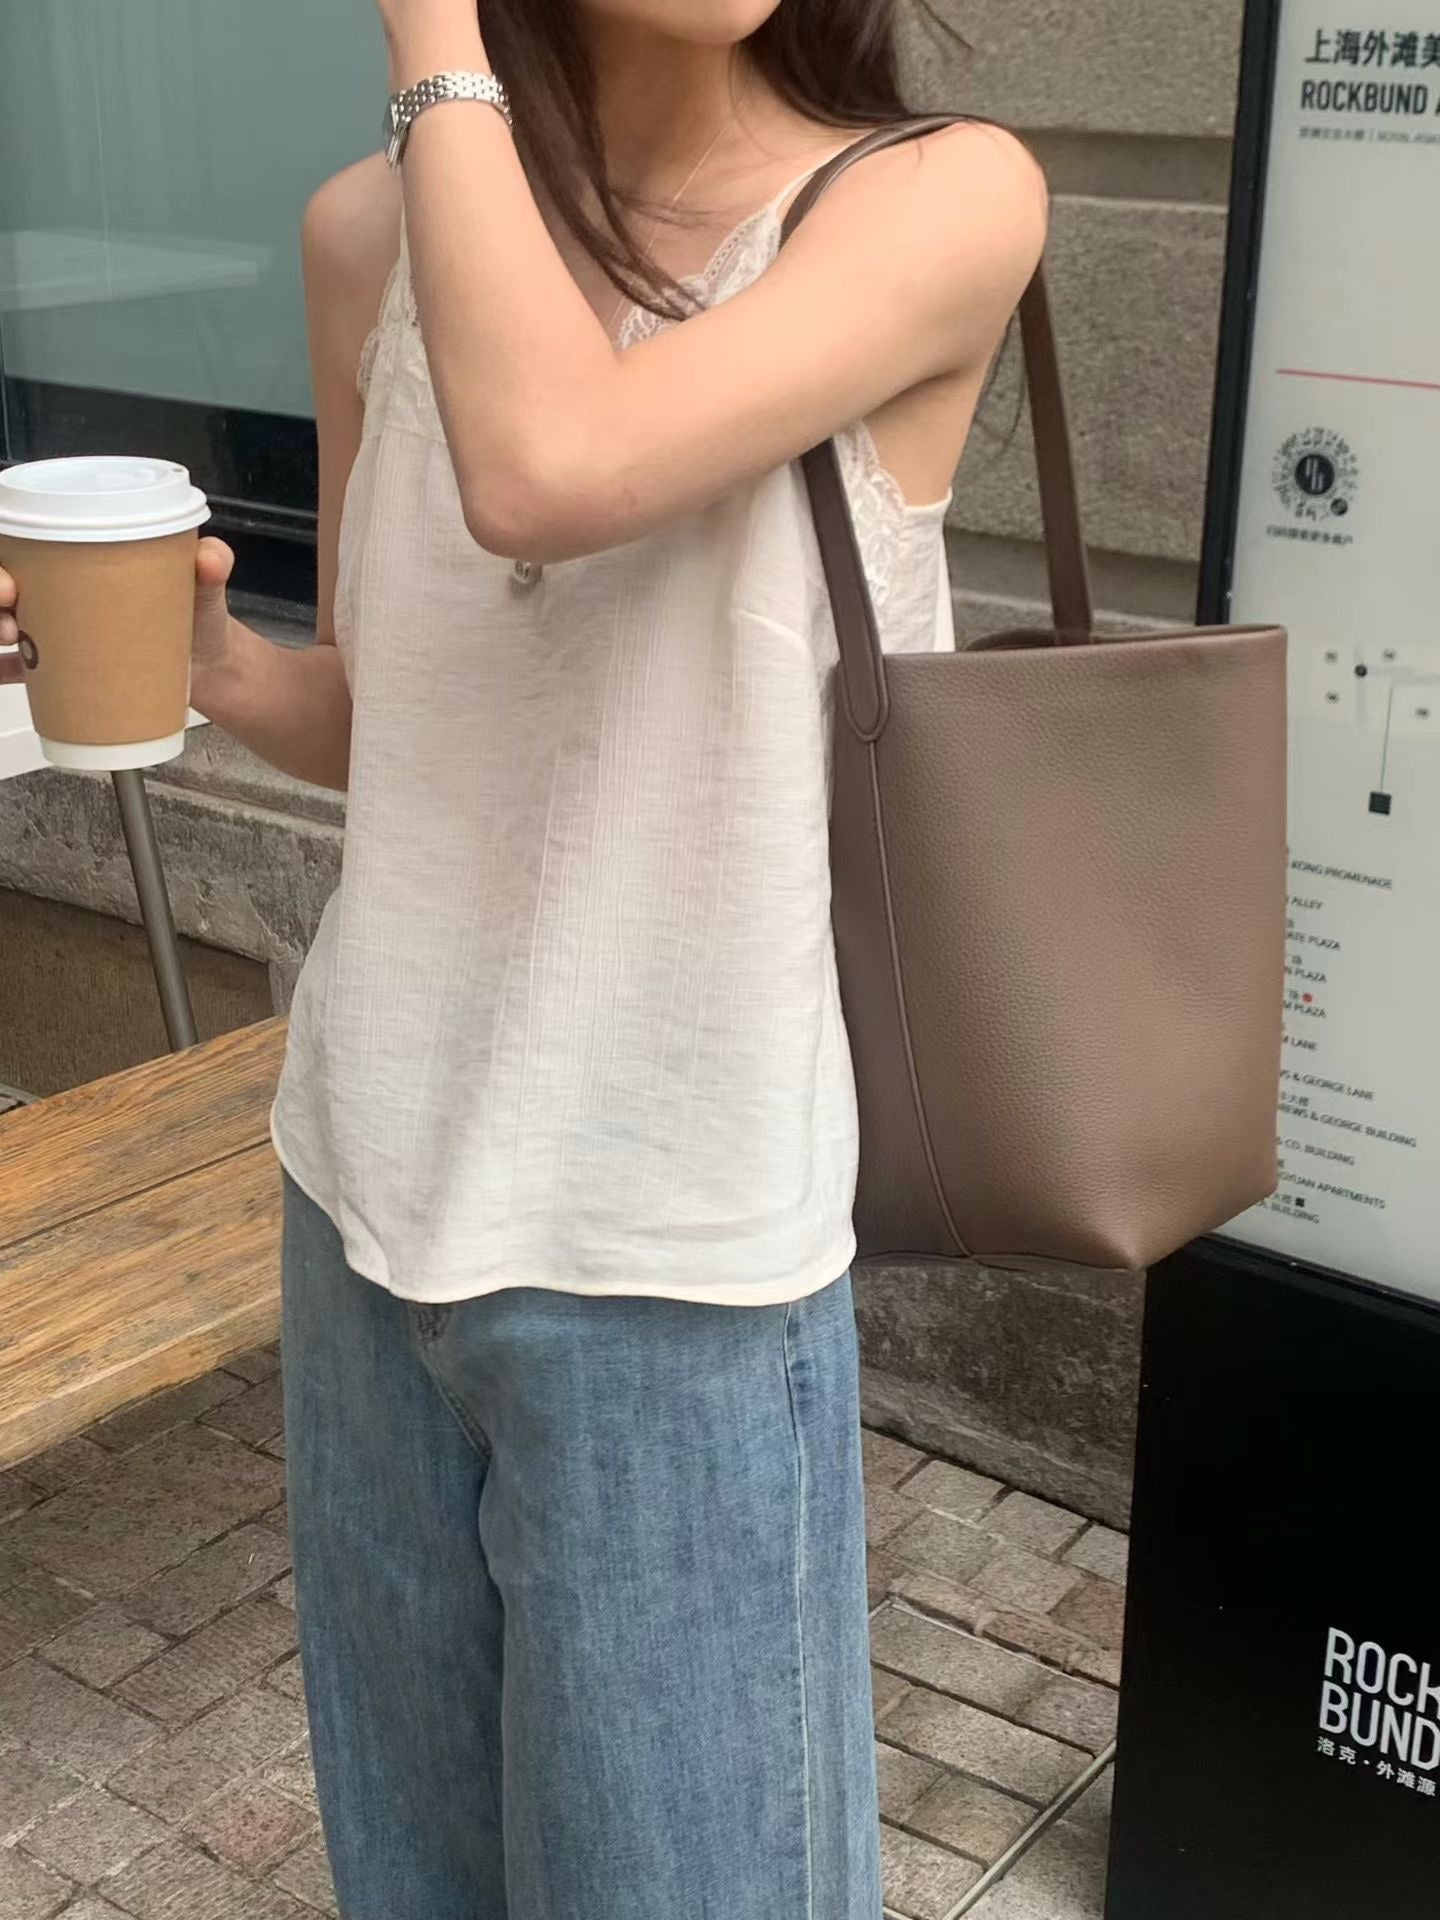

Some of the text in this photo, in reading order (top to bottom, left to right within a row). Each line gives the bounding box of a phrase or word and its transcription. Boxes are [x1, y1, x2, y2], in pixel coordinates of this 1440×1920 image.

[1300, 79, 1428, 115] ROCKBUND
[1291, 896, 1323, 910] ALLEY
[1308, 936, 1341, 950] PLAZA
[1295, 968, 1327, 983] PLAZA
[1294, 1003, 1326, 1018] PLAZA
[1302, 1074, 1344, 1093] GEORGE
[1347, 1087, 1375, 1101] LANE
[1320, 1114, 1362, 1133] GEORGE
[1365, 1125, 1417, 1148] BUILDING
[1305, 1145, 1355, 1165] BUILDING
[1317, 1182, 1386, 1209] APARTMENTS
[1271, 1201, 1320, 1224] BUILDING
[1325, 1626, 1440, 1720] ROCK
[1319, 1680, 1440, 1771] BUND
